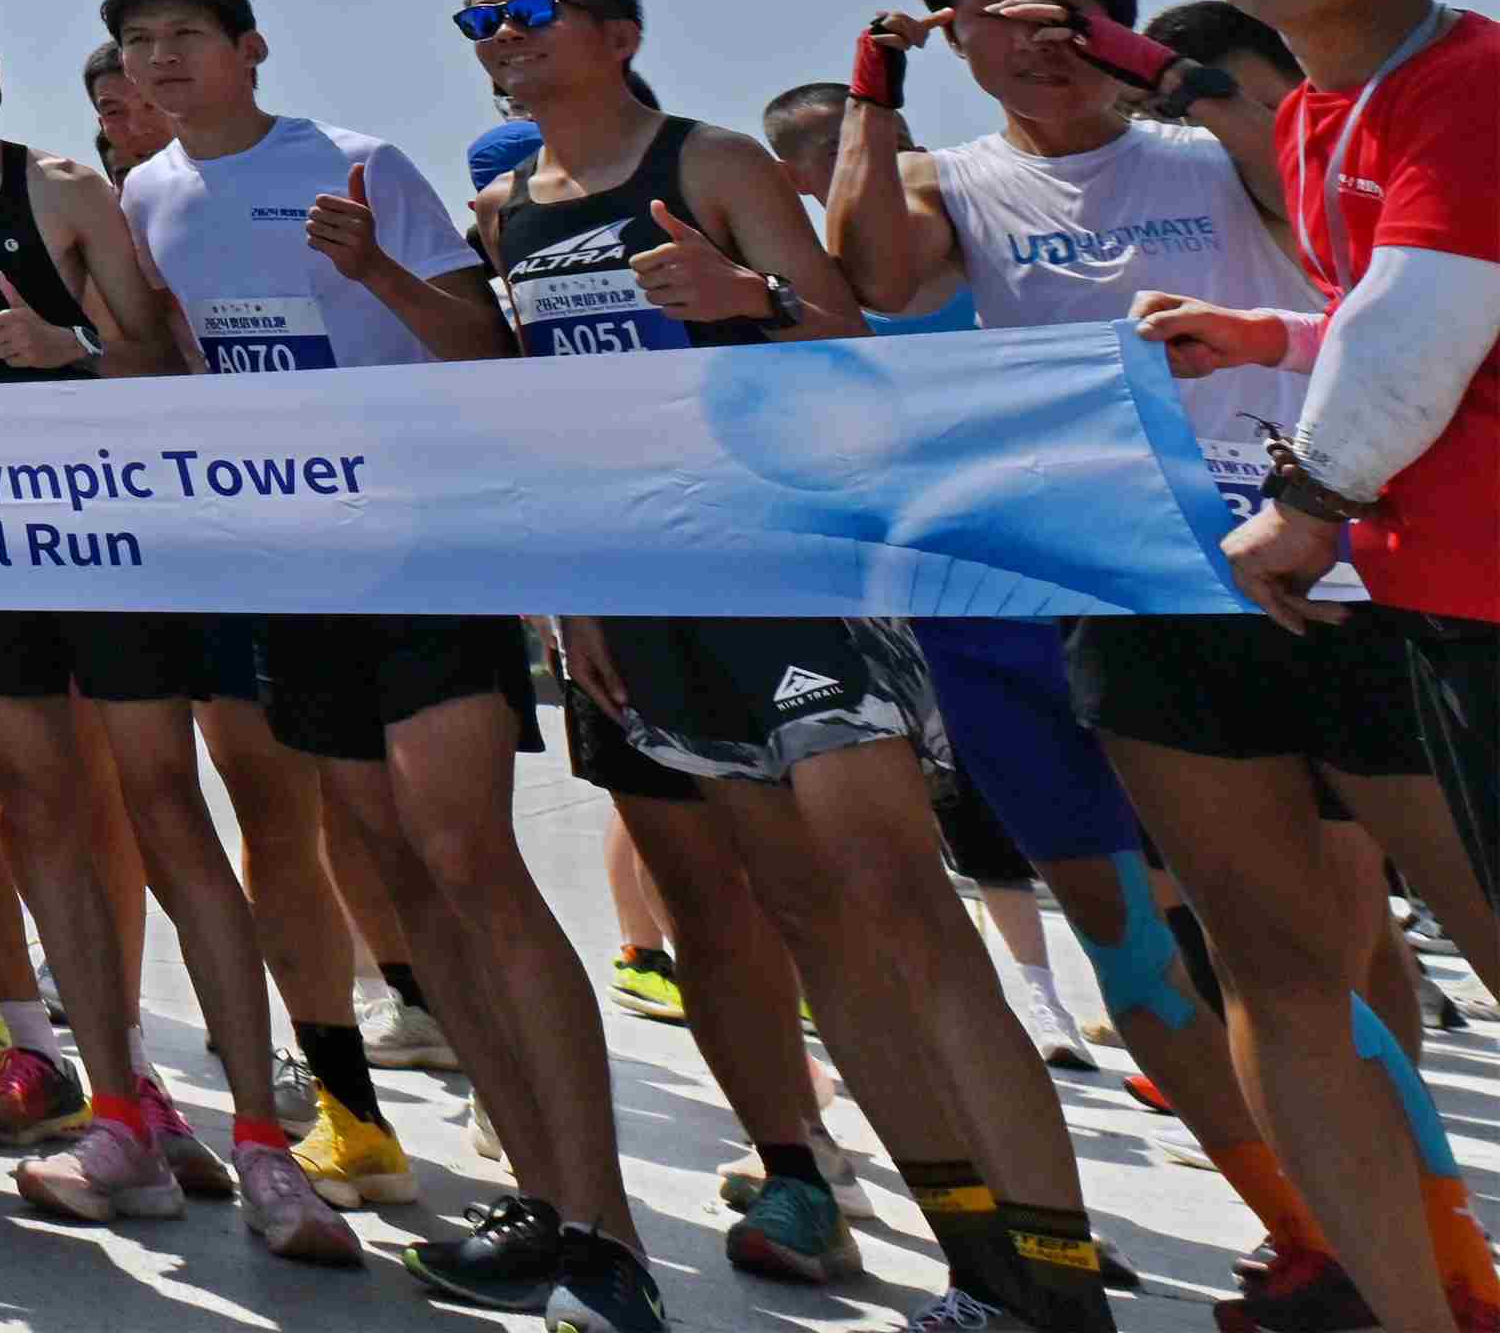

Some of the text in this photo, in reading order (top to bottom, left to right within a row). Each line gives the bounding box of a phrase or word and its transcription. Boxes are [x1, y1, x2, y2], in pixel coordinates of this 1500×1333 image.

[508, 245, 625, 281] ALTRA
[552, 320, 647, 357] A051
[217, 344, 296, 374] A070
[160, 450, 366, 499] Tower
[26, 522, 144, 568] Run
[776, 686, 845, 712] NIKE TRAIL
